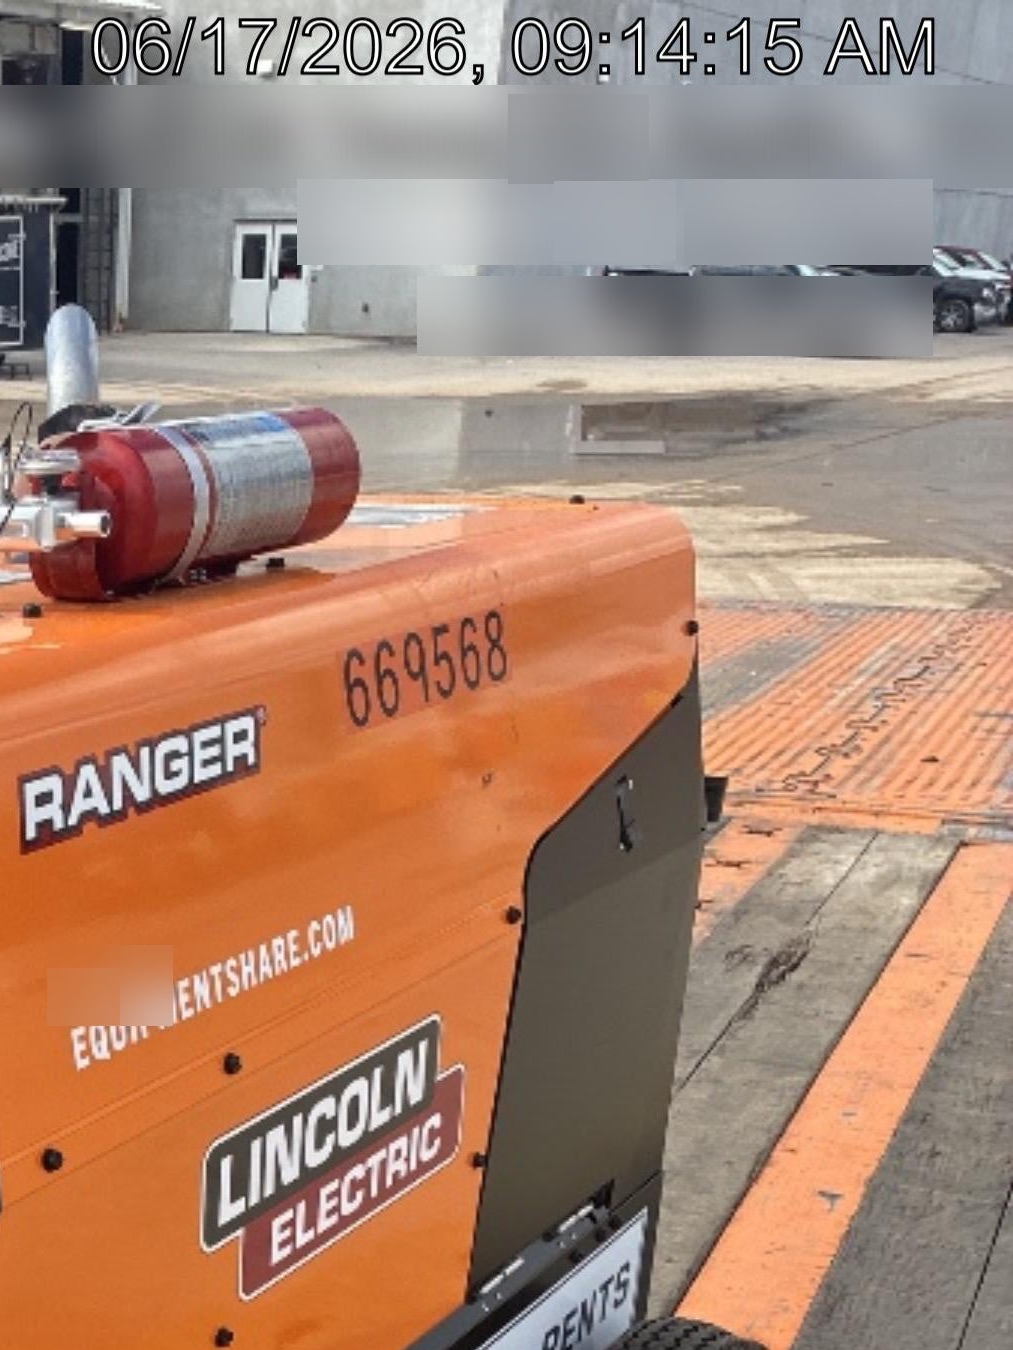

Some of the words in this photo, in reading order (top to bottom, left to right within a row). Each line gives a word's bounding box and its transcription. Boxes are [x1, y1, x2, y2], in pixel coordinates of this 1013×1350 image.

[344, 610, 507, 726] 669568
[23, 713, 257, 842] RANGER
[217, 1036, 429, 1227] LINCOLN
[268, 1112, 442, 1266] ELECTRIC
